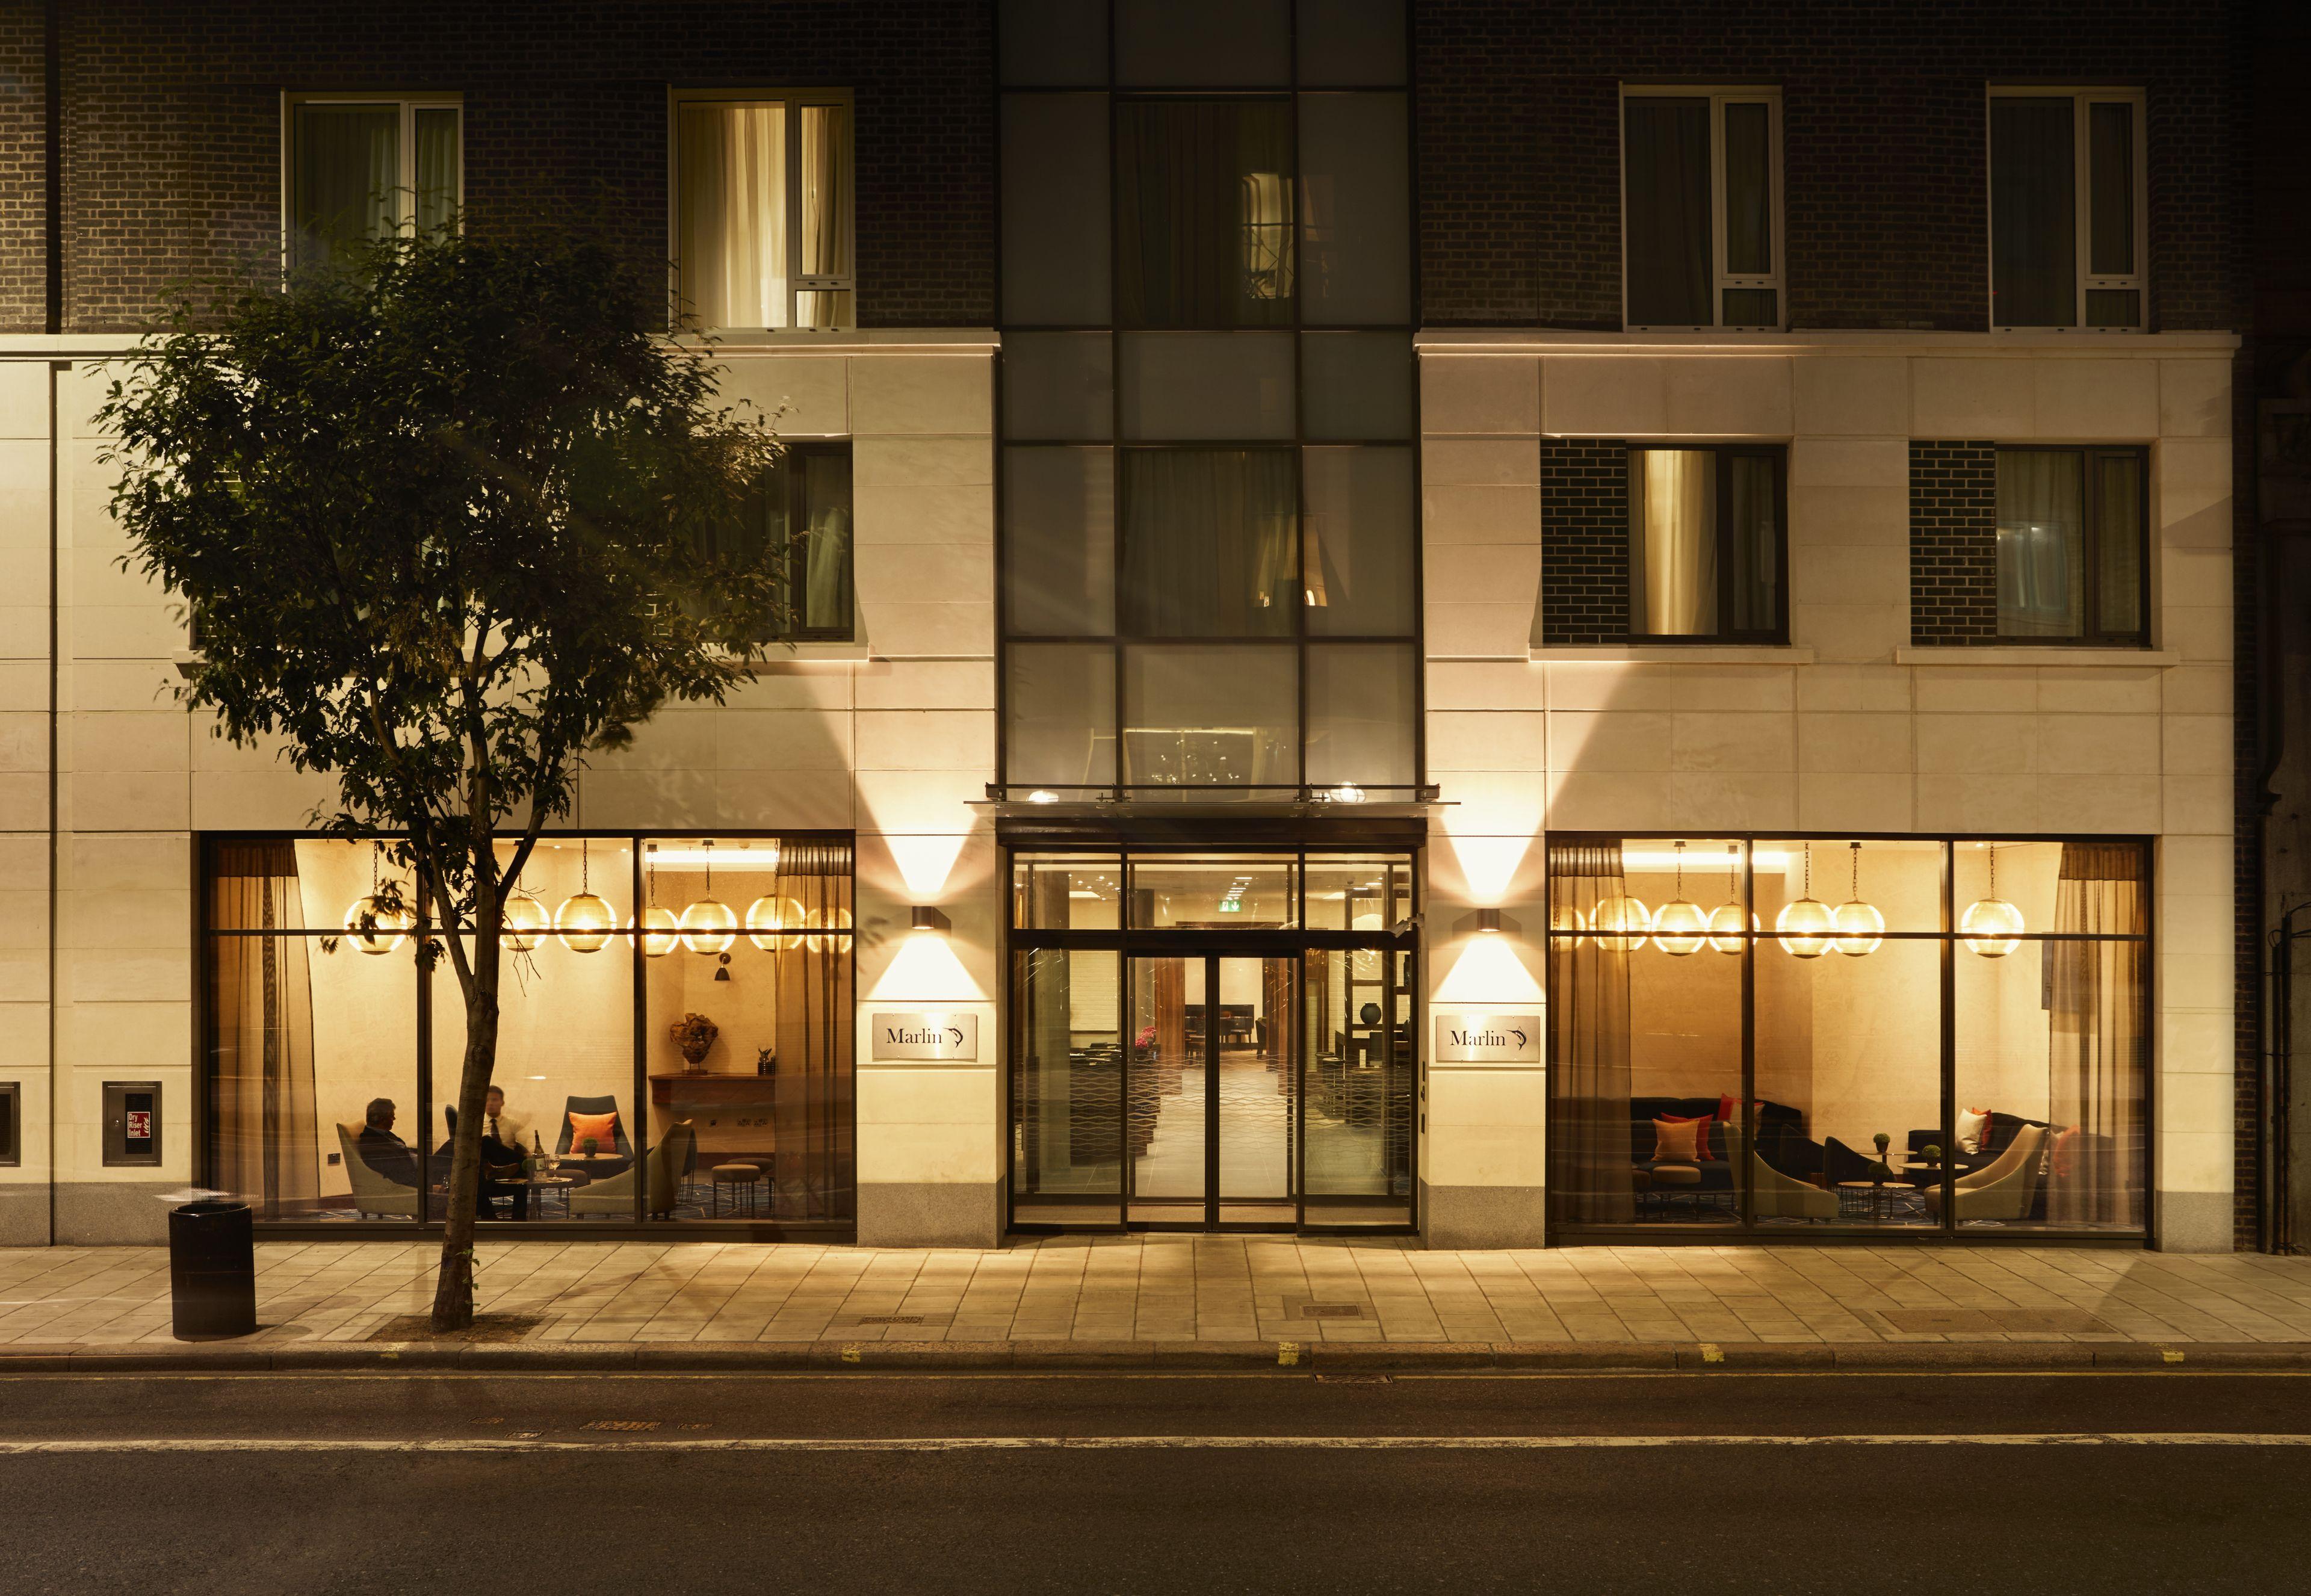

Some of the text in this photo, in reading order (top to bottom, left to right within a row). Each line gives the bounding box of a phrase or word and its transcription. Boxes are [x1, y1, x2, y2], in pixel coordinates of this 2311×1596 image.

[886, 1028, 942, 1044] Marlin
[1450, 1030, 1506, 1046] Marlin
[129, 1113, 138, 1122] Dry
